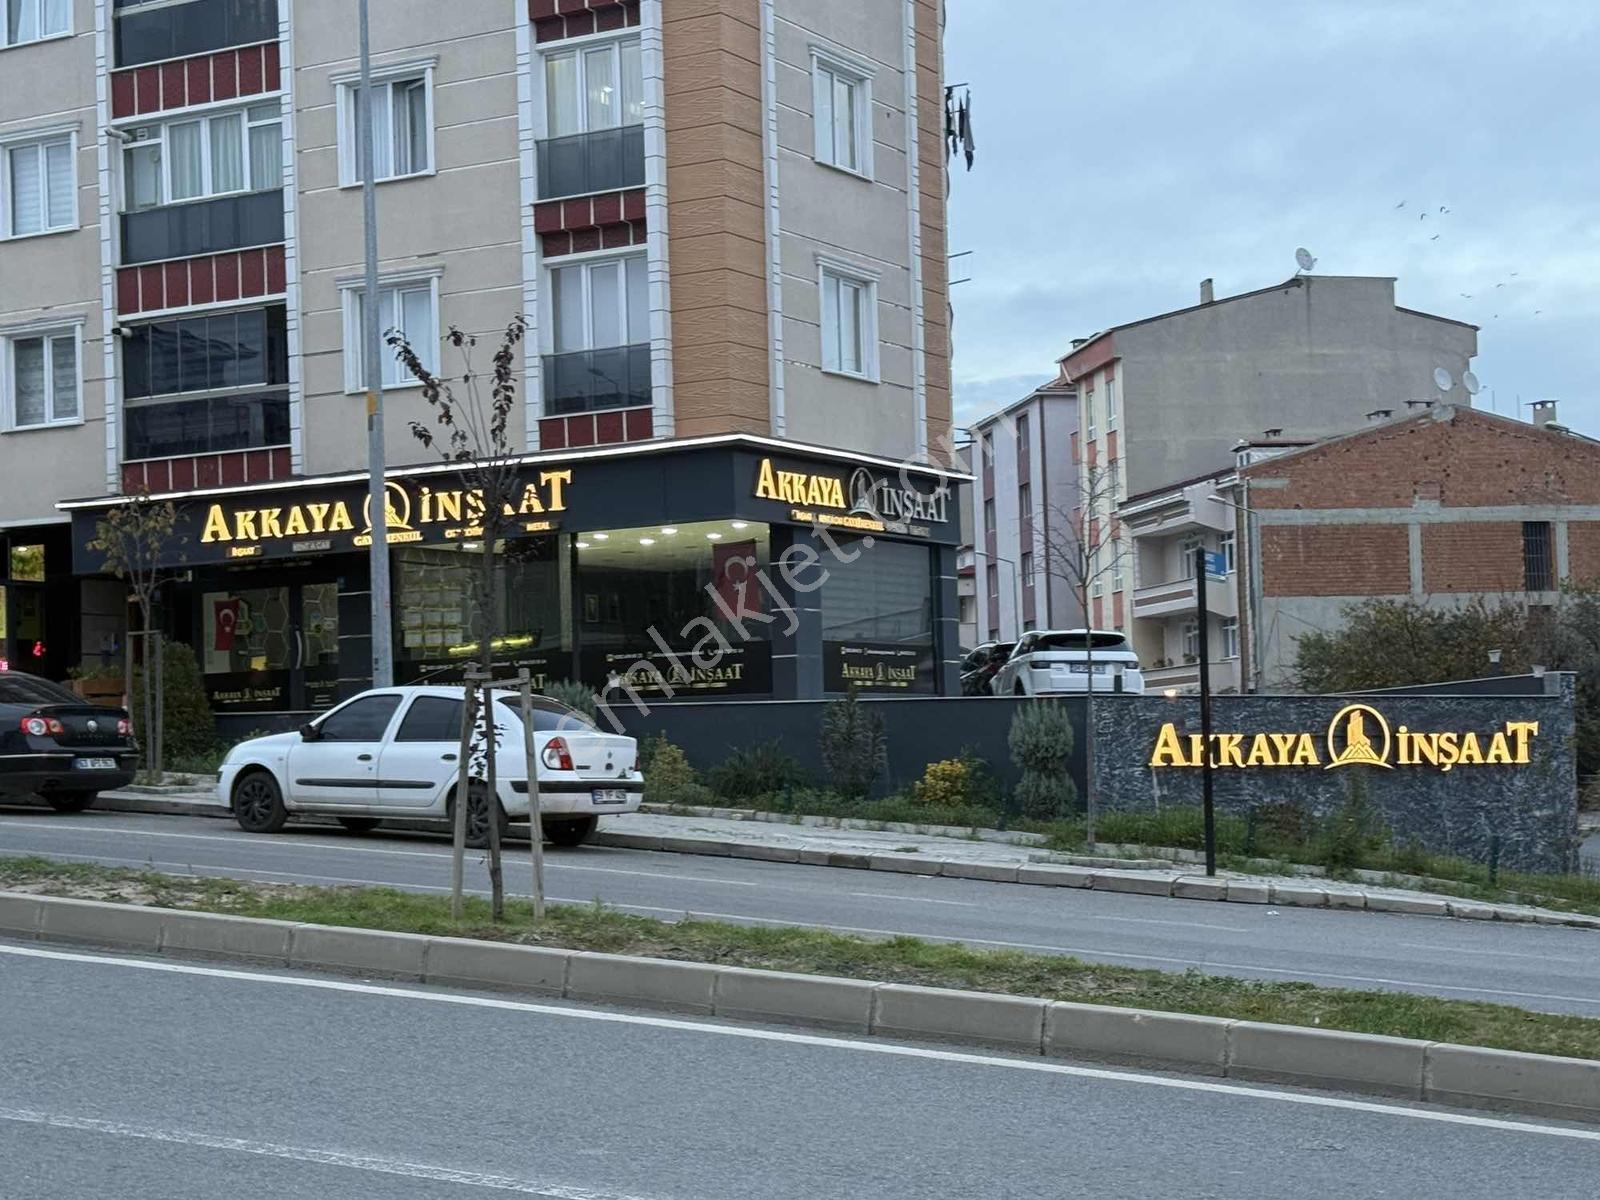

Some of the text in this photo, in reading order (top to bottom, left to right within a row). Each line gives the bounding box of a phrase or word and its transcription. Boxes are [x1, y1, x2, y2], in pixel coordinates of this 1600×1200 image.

[754, 457, 846, 509] AKKAYA
[200, 501, 355, 543] AKKAYA
[1148, 720, 1539, 771] AKKAYA İNŞAAT
